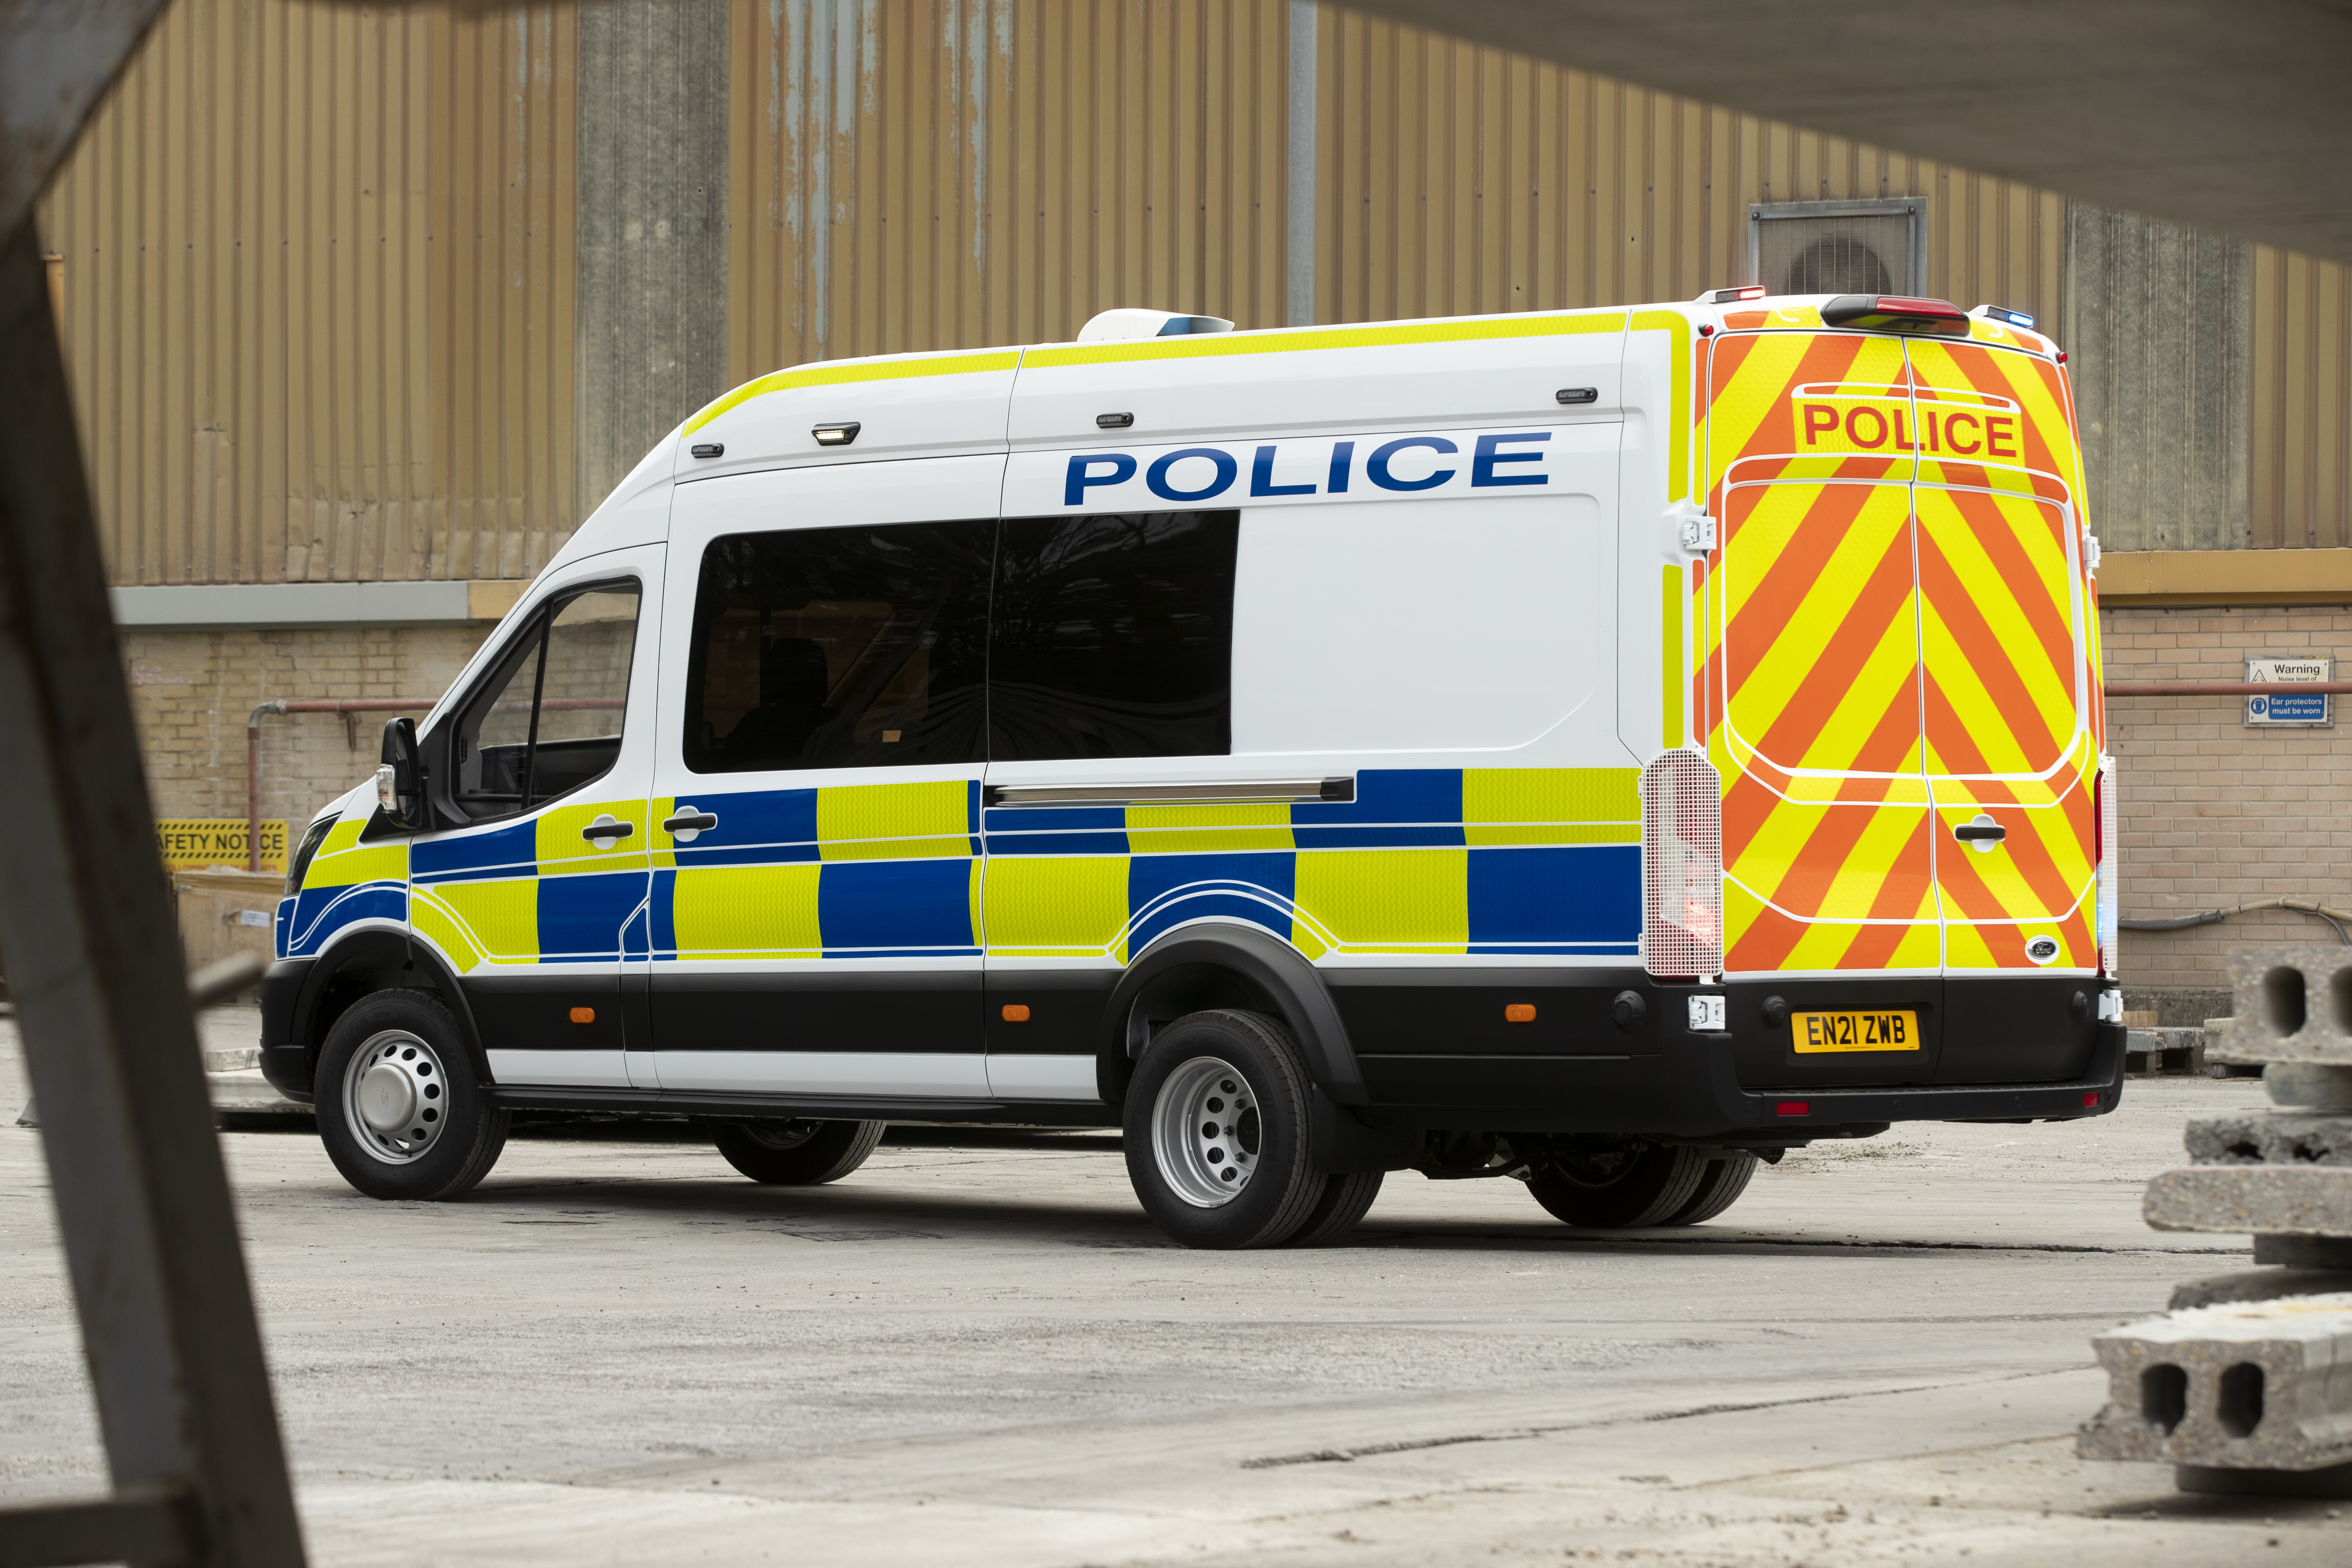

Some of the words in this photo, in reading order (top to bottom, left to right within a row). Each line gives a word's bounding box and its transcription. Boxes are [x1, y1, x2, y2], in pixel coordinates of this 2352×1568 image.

[1803, 404, 2017, 458] POLICE
[1064, 432, 1552, 506] POLICE
[2274, 664, 2320, 675] Warning
[156, 834, 209, 850] AFETY
[216, 834, 283, 850] NOTCE
[1806, 1015, 1858, 1045] EN21
[1863, 1015, 1905, 1044] ZWB
